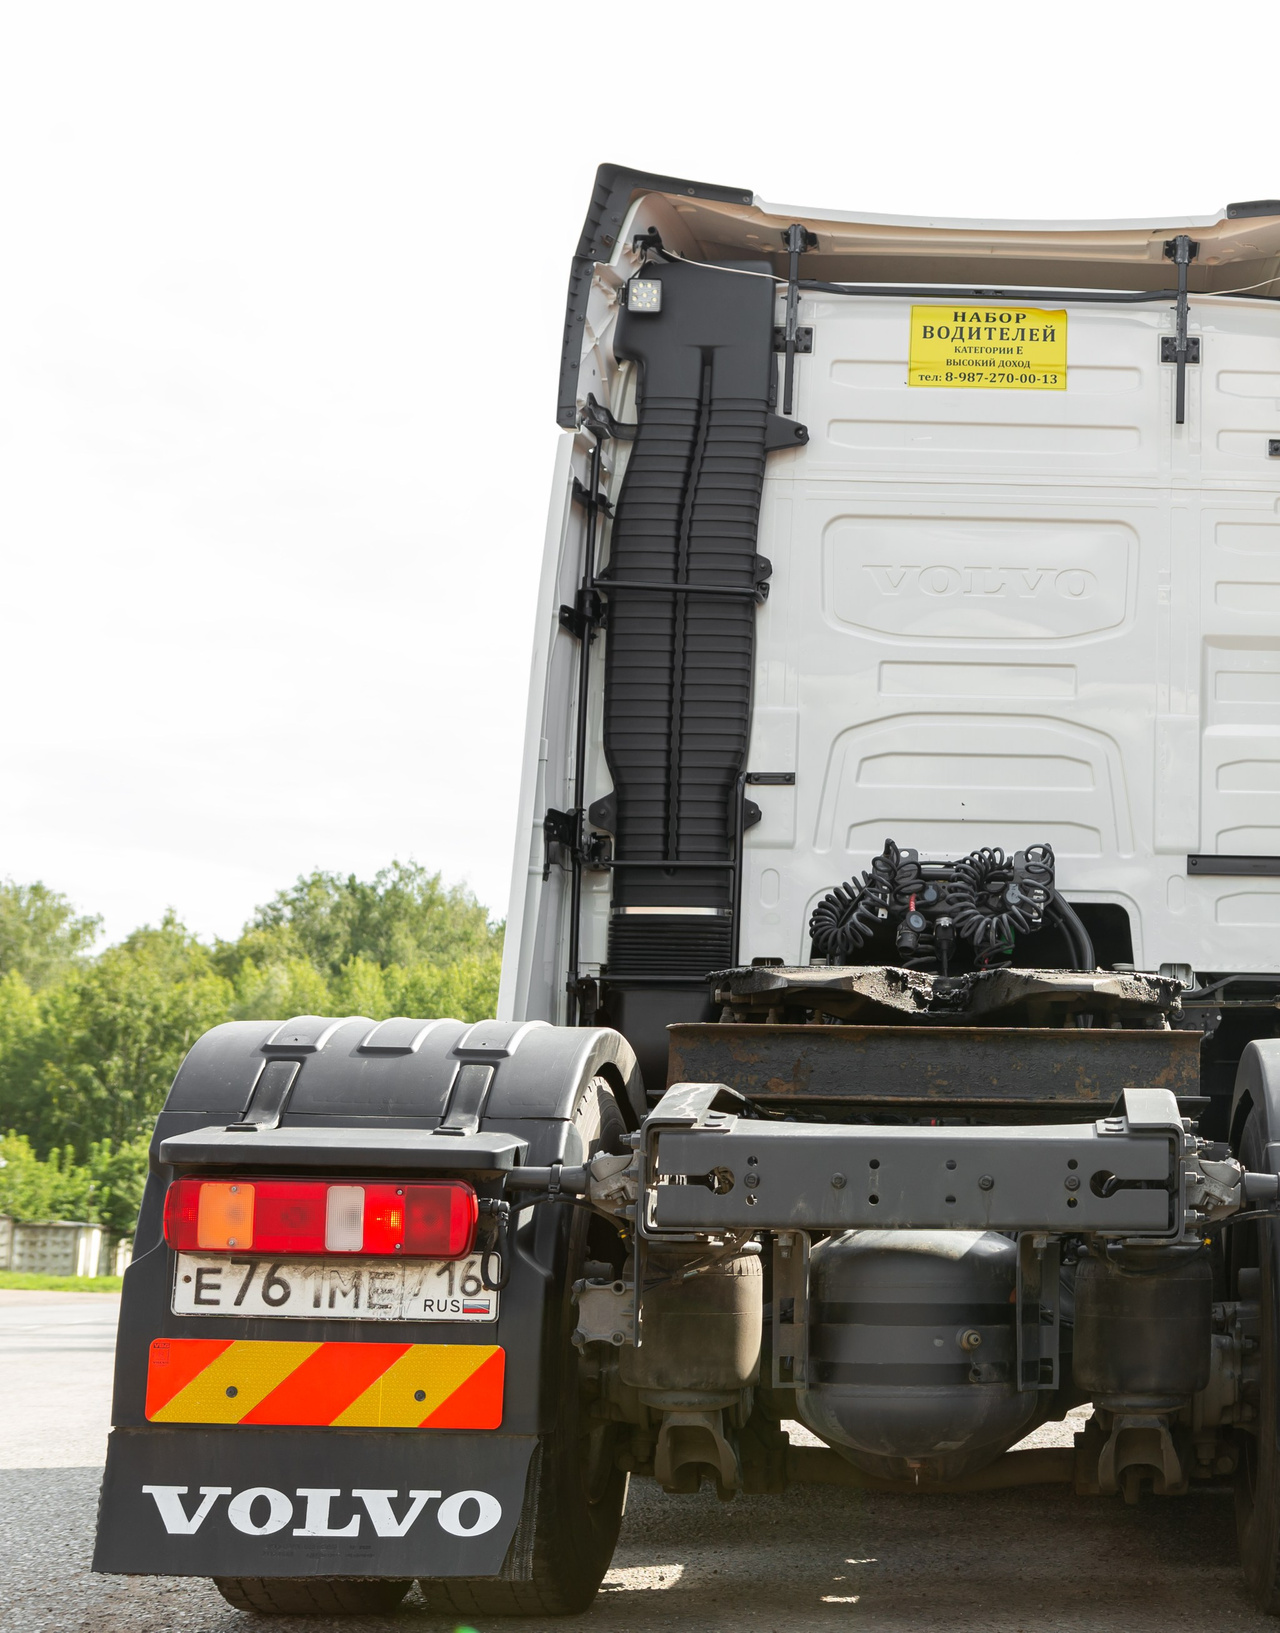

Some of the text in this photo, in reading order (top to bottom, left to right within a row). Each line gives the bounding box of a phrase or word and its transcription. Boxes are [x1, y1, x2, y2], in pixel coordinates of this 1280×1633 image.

[953, 311, 1027, 324] НАБОР
[922, 325, 1056, 342] ВОДИТЕЛЕЙ
[954, 346, 1014, 355] КАТЕГОРИИ
[946, 358, 1031, 369] ВЫСОКИЙ ДОХОД
[918, 372, 1058, 384] тел: 8-987-270-00-13
[862, 564, 1099, 600] VOLVO
[424, 1299, 461, 1313] RUS
[141, 1485, 502, 1537] VOLVO
